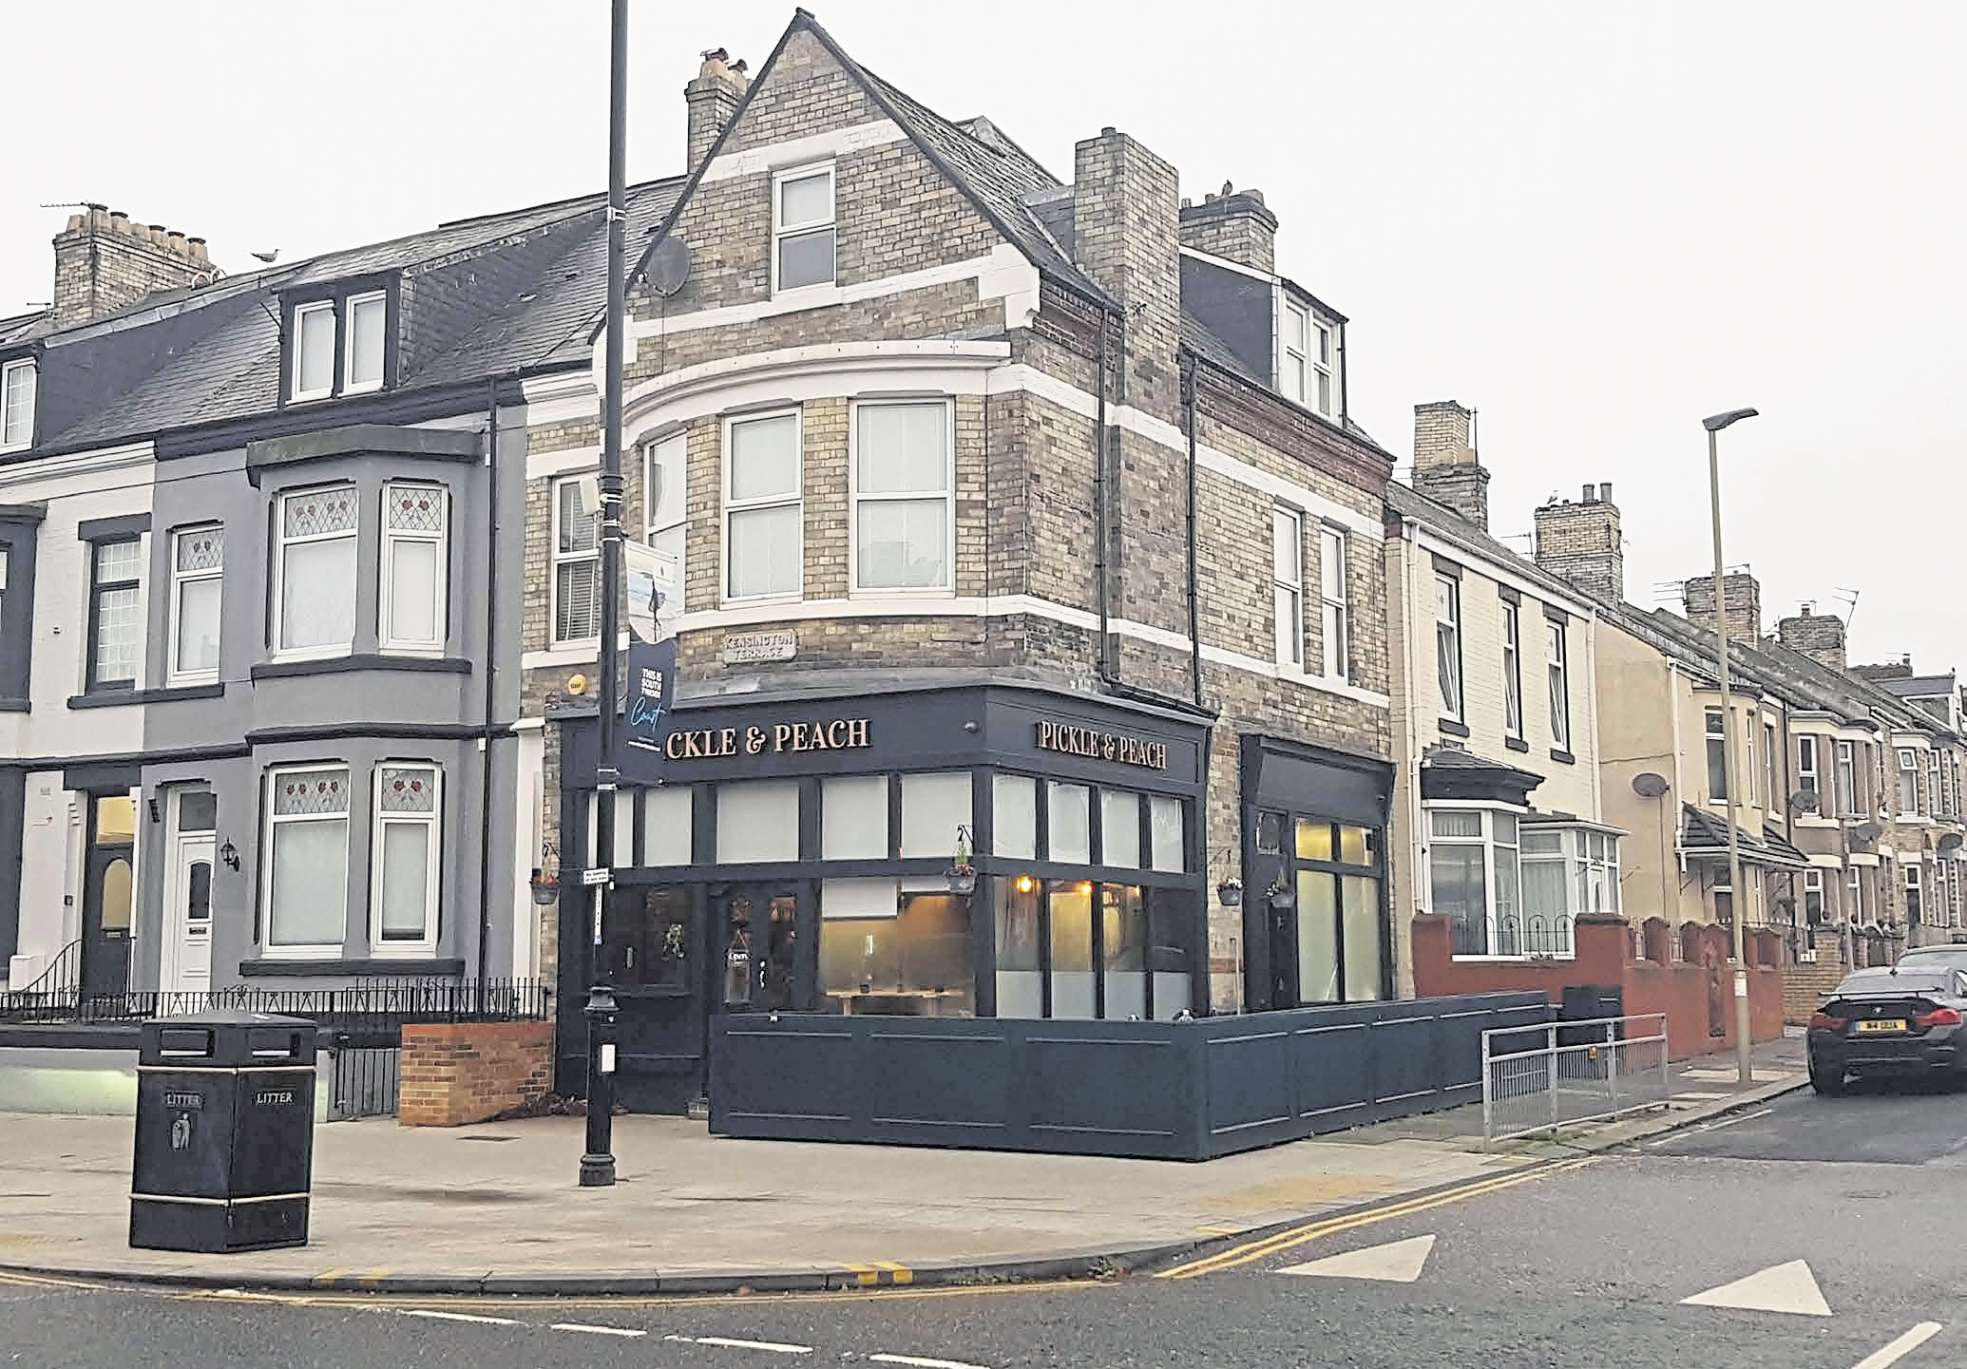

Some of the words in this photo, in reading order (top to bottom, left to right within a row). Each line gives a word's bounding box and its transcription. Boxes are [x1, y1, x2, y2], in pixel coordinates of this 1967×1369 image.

[726, 634, 794, 649] KENSINGTON
[666, 728, 738, 760] CKLE
[745, 726, 766, 755] &
[774, 719, 871, 752] PEACH
[1039, 720, 1099, 757] PICKLE
[1103, 733, 1115, 760] &
[1119, 736, 1167, 769] PEACH
[166, 1093, 201, 1105] LITTER
[256, 1092, 293, 1105] LITTER
